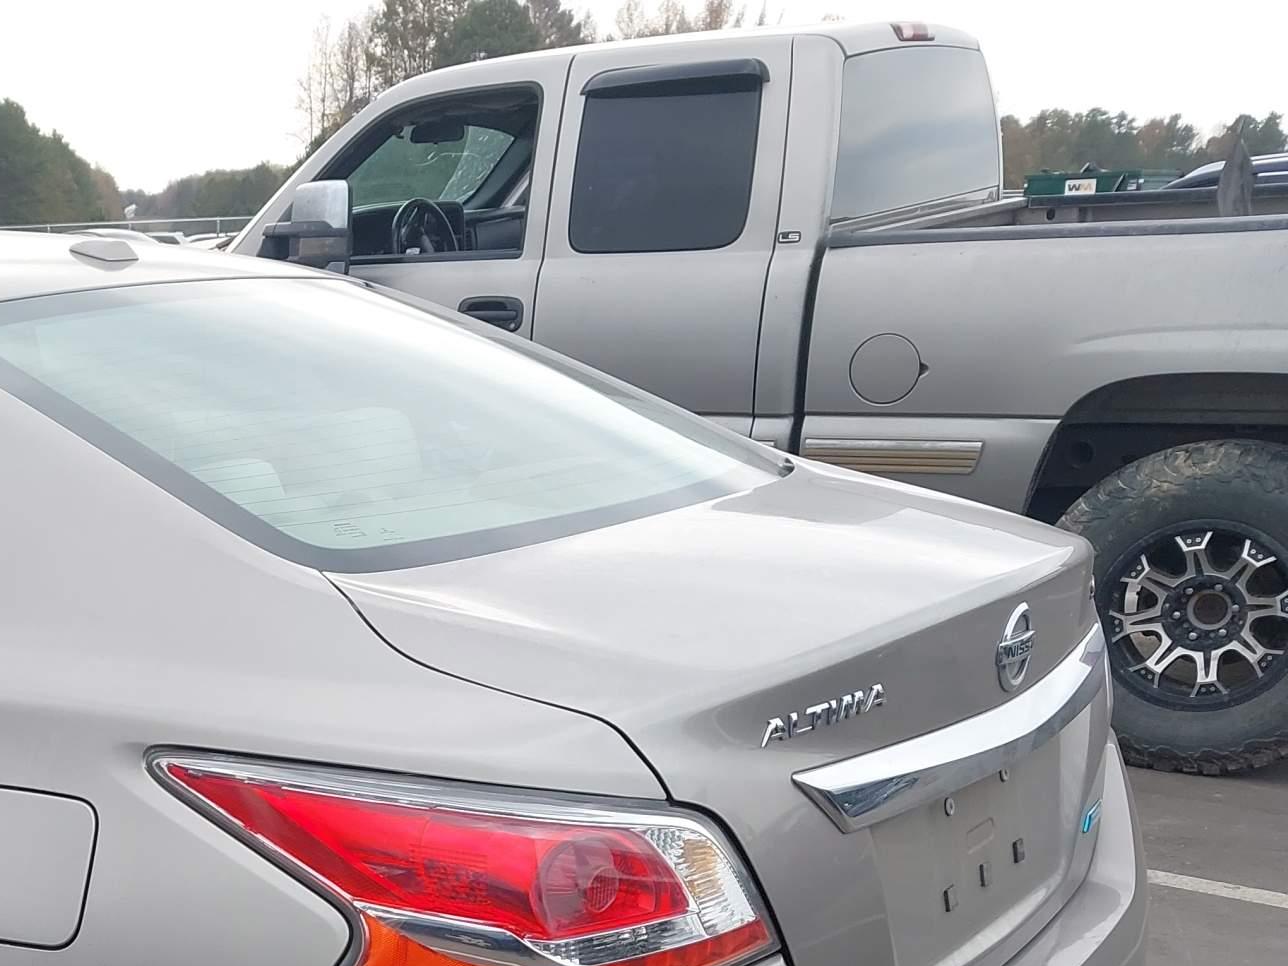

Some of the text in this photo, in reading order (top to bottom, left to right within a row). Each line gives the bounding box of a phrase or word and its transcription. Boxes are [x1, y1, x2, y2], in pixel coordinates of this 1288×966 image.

[1067, 183, 1093, 192] WM
[779, 232, 799, 241] LS
[1007, 639, 1033, 659] NISS
[760, 683, 885, 748] ALTIMA
